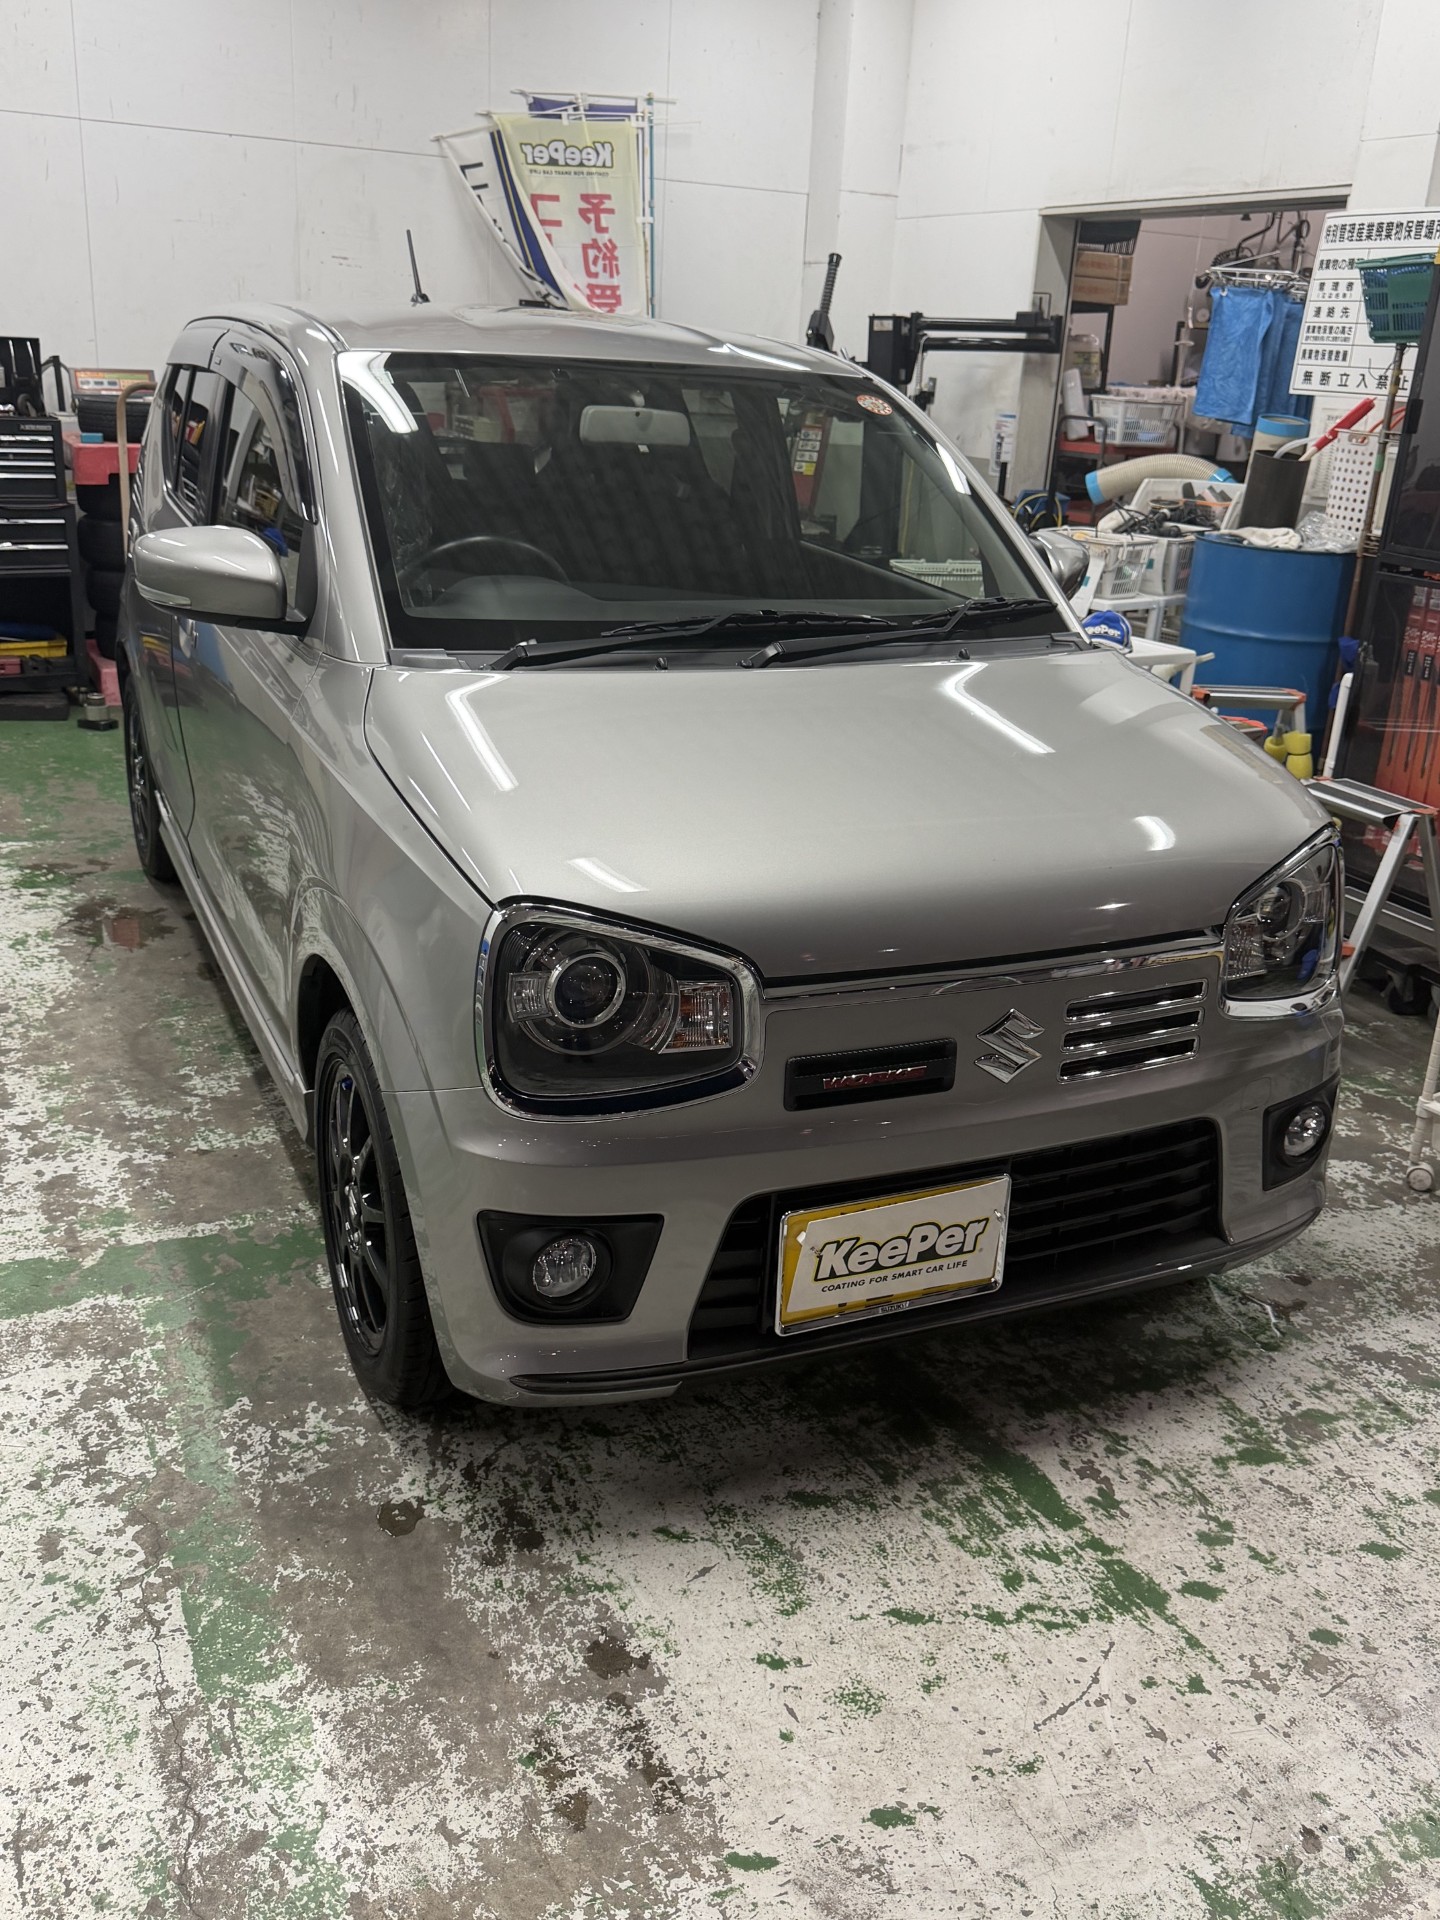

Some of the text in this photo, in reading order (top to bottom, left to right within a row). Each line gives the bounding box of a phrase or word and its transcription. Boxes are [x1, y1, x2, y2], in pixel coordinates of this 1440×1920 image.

[1084, 624, 1121, 638] eePer
[813, 1217, 989, 1282] KeePer
[821, 1259, 968, 1293] COATING FOR SMART CAR LIFE
